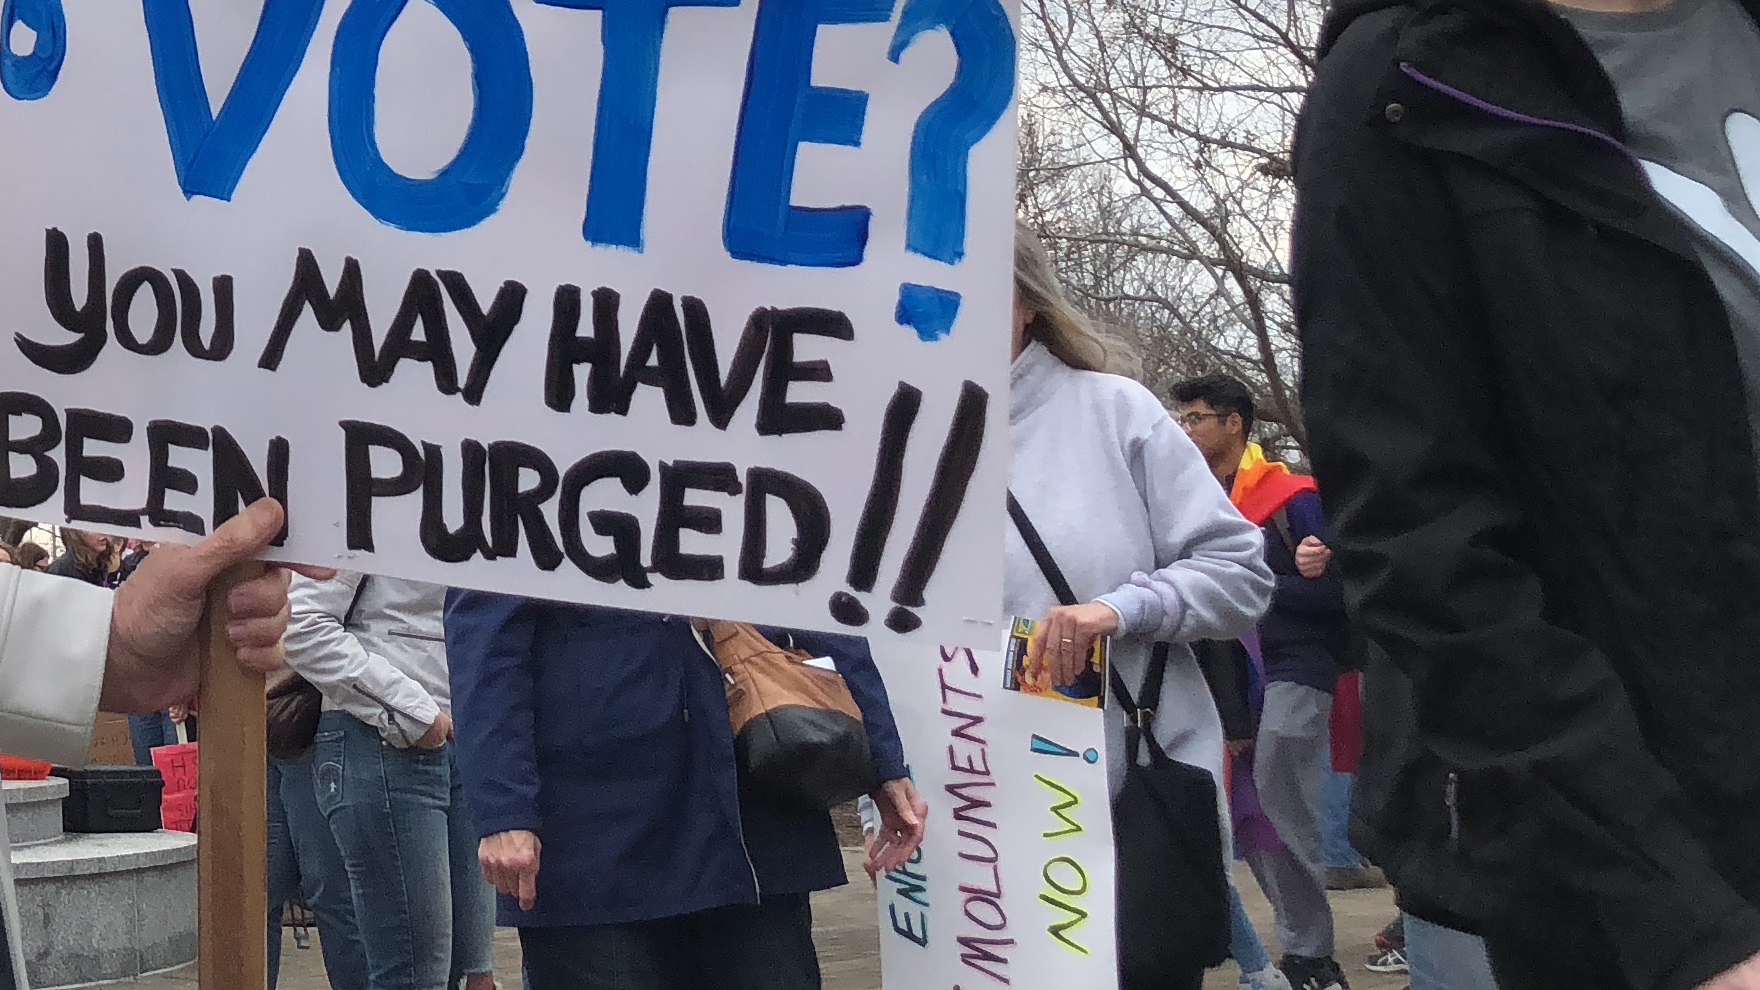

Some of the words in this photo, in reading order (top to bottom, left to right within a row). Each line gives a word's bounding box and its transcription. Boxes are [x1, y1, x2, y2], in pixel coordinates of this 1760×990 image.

[257, 247, 528, 407] MAY
[544, 283, 855, 437] HAVE
[938, 644, 1016, 990] MOLUMENTS
[1029, 732, 1100, 955] NOW!
